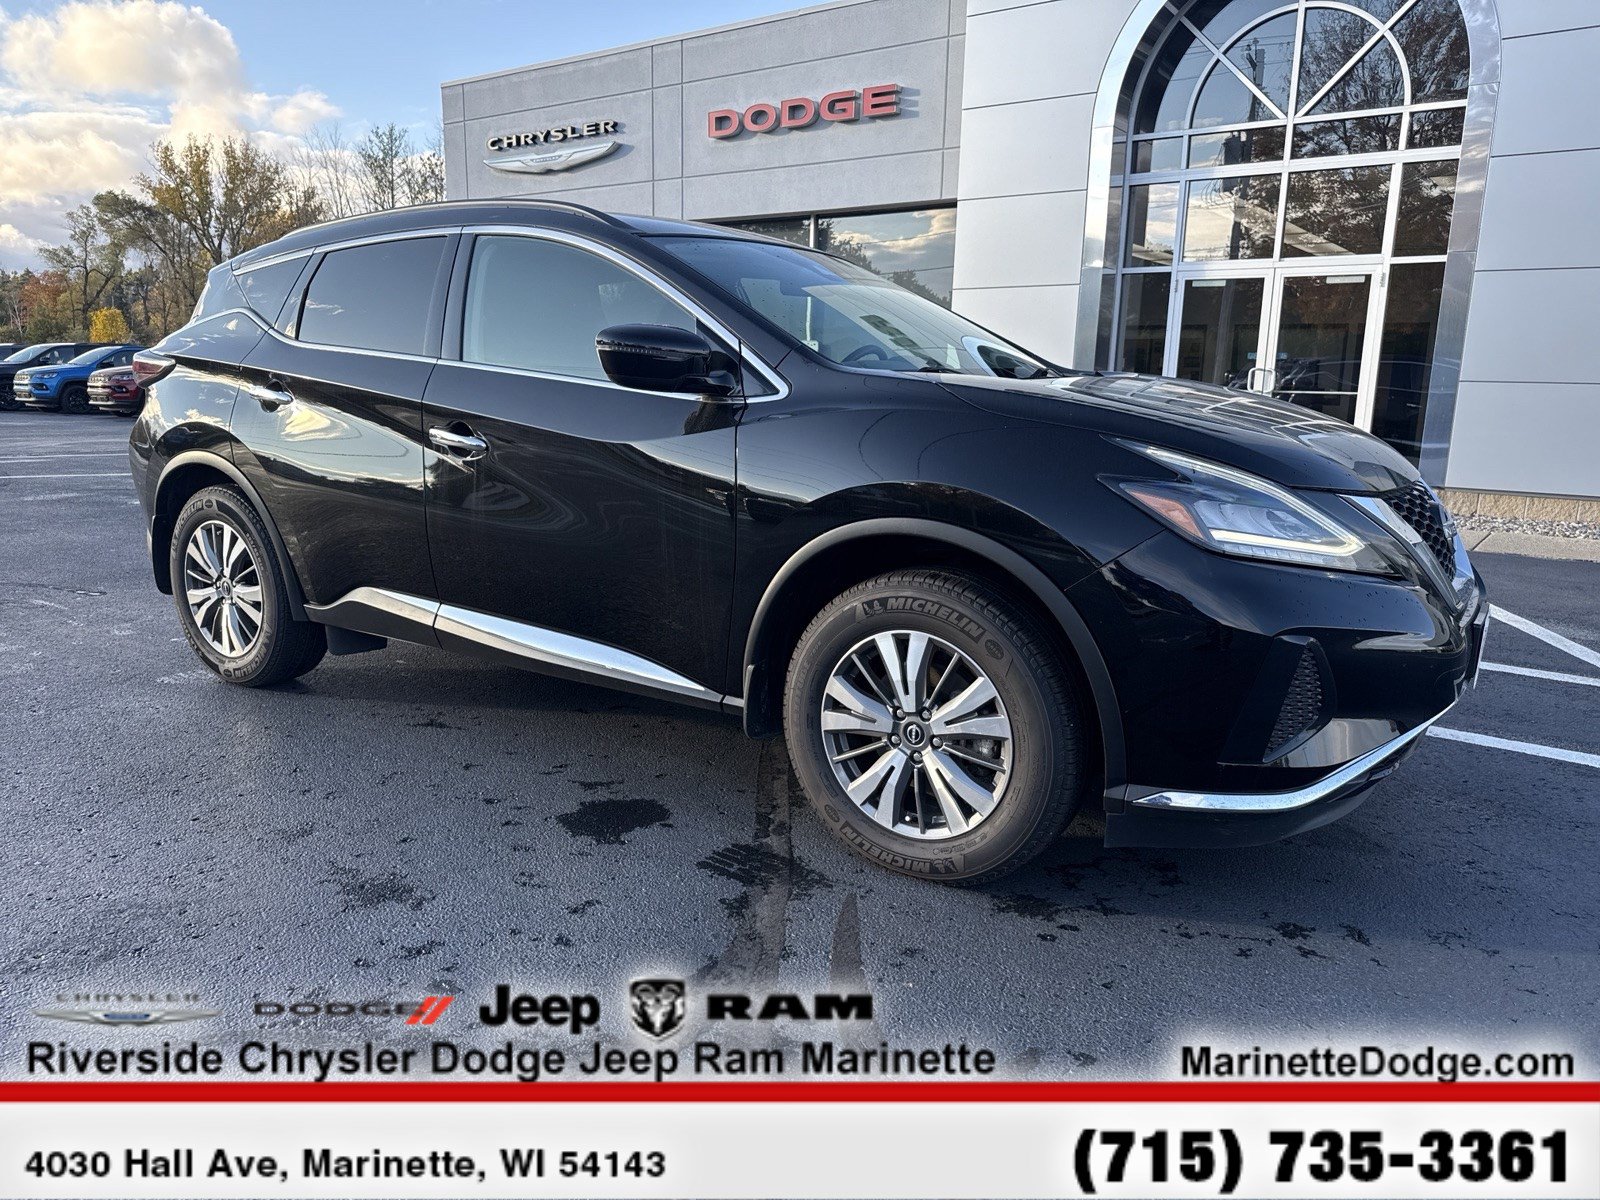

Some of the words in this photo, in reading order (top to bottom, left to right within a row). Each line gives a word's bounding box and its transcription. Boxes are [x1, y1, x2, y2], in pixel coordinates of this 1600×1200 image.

[708, 83, 902, 139] DODGE
[486, 120, 618, 151] CHRYSLER
[886, 597, 984, 638] MICHELIN
[840, 826, 930, 874] MICHELIN
